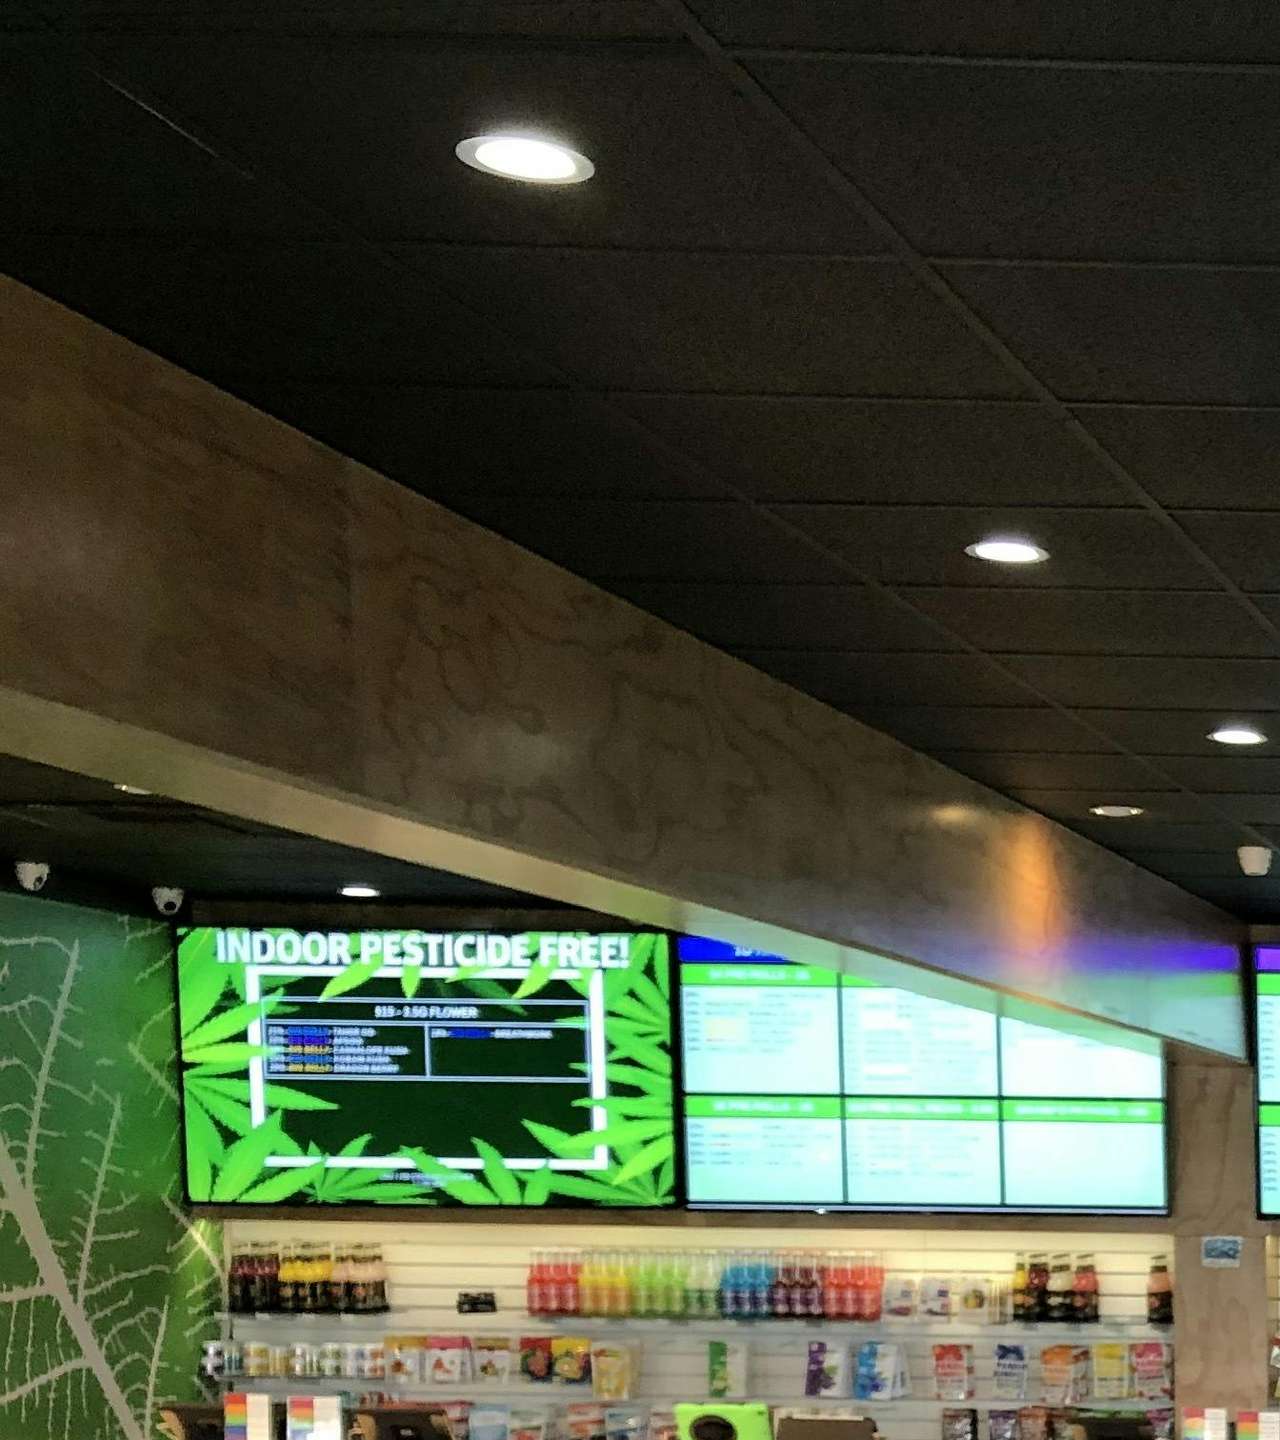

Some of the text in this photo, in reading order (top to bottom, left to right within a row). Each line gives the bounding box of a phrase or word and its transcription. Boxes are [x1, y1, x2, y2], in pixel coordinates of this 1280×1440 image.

[216, 931, 630, 969] INDOOR PESTICIDE FREE!
[429, 1005, 479, 1019] FLOWER
